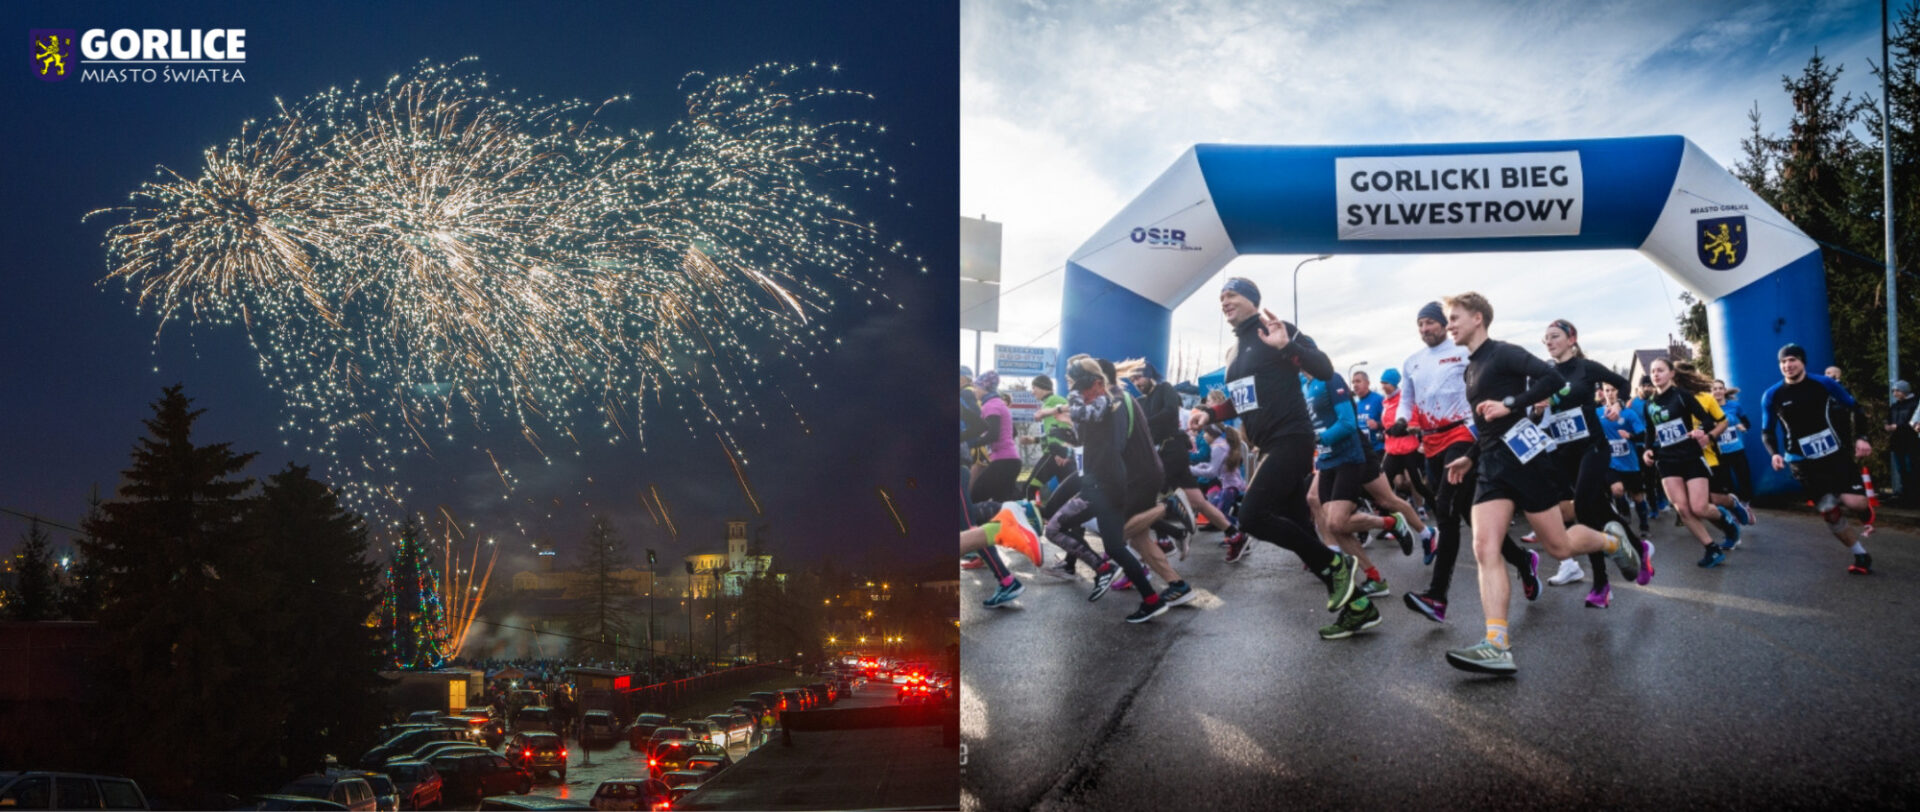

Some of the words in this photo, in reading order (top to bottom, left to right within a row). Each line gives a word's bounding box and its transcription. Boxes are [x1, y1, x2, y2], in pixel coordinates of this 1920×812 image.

[1350, 167, 1490, 192] GORLICKI
[1501, 165, 1569, 188] BIEG
[1346, 199, 1576, 226] SYLWESTROWY
[1690, 206, 1718, 214] MIASTO
[1555, 418, 1578, 436] 193
[1810, 437, 1830, 454] 171
